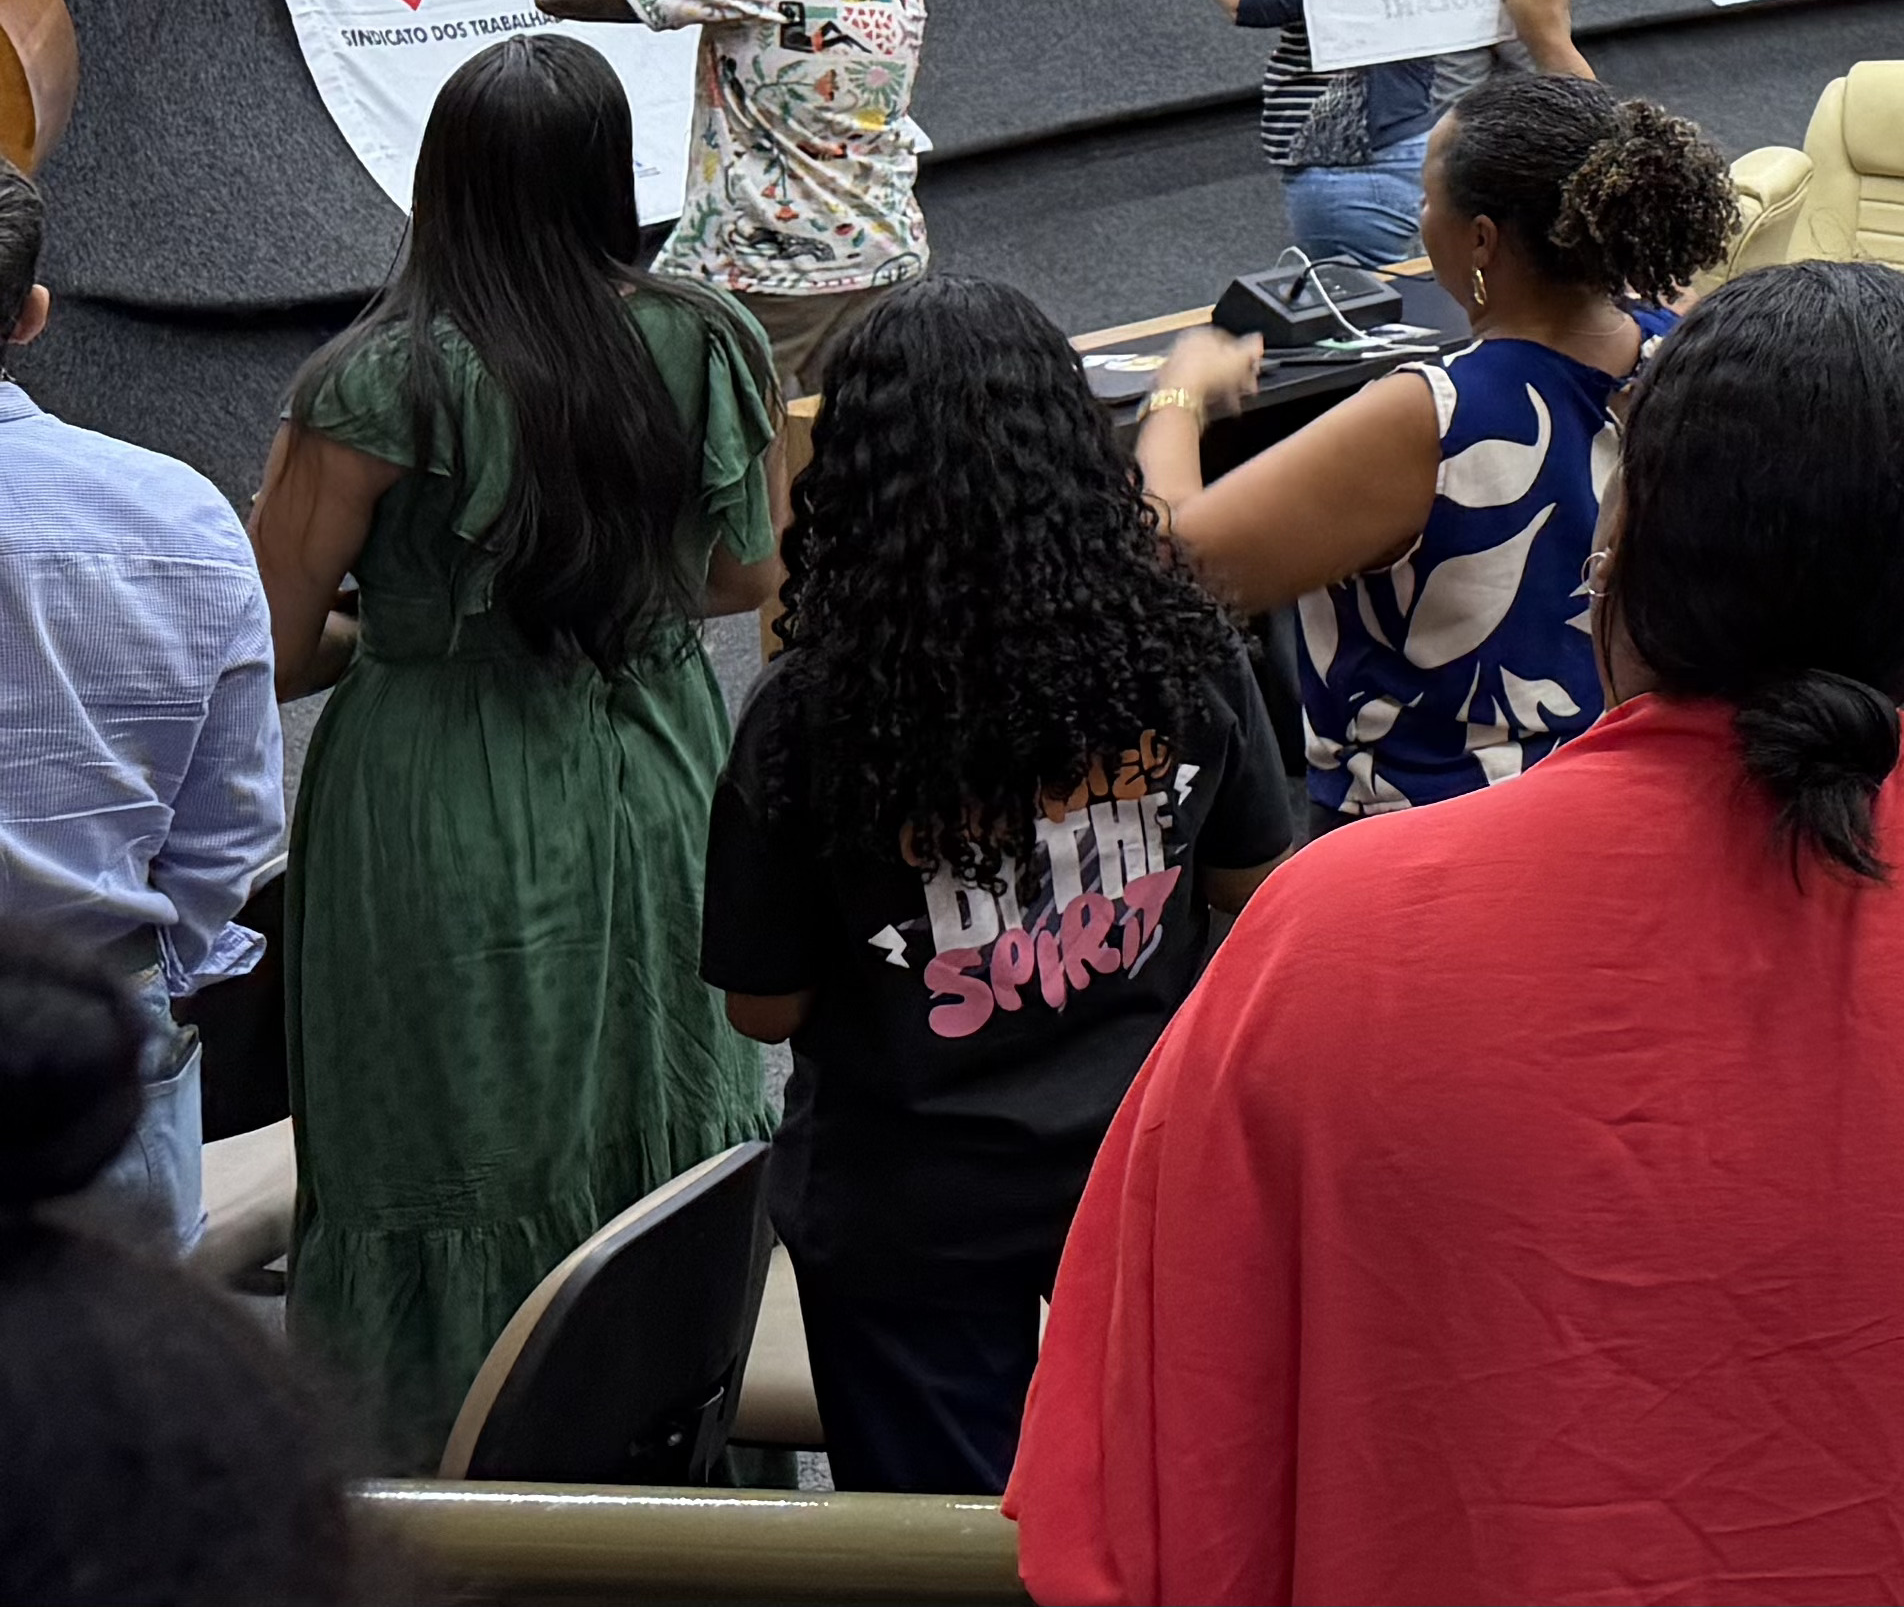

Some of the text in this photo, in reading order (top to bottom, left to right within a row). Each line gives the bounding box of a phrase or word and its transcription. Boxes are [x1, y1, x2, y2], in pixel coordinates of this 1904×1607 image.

[341, 28, 428, 48] SINDICATO
[431, 22, 468, 44] DOS
[923, 864, 1183, 1039] SPIRIT
